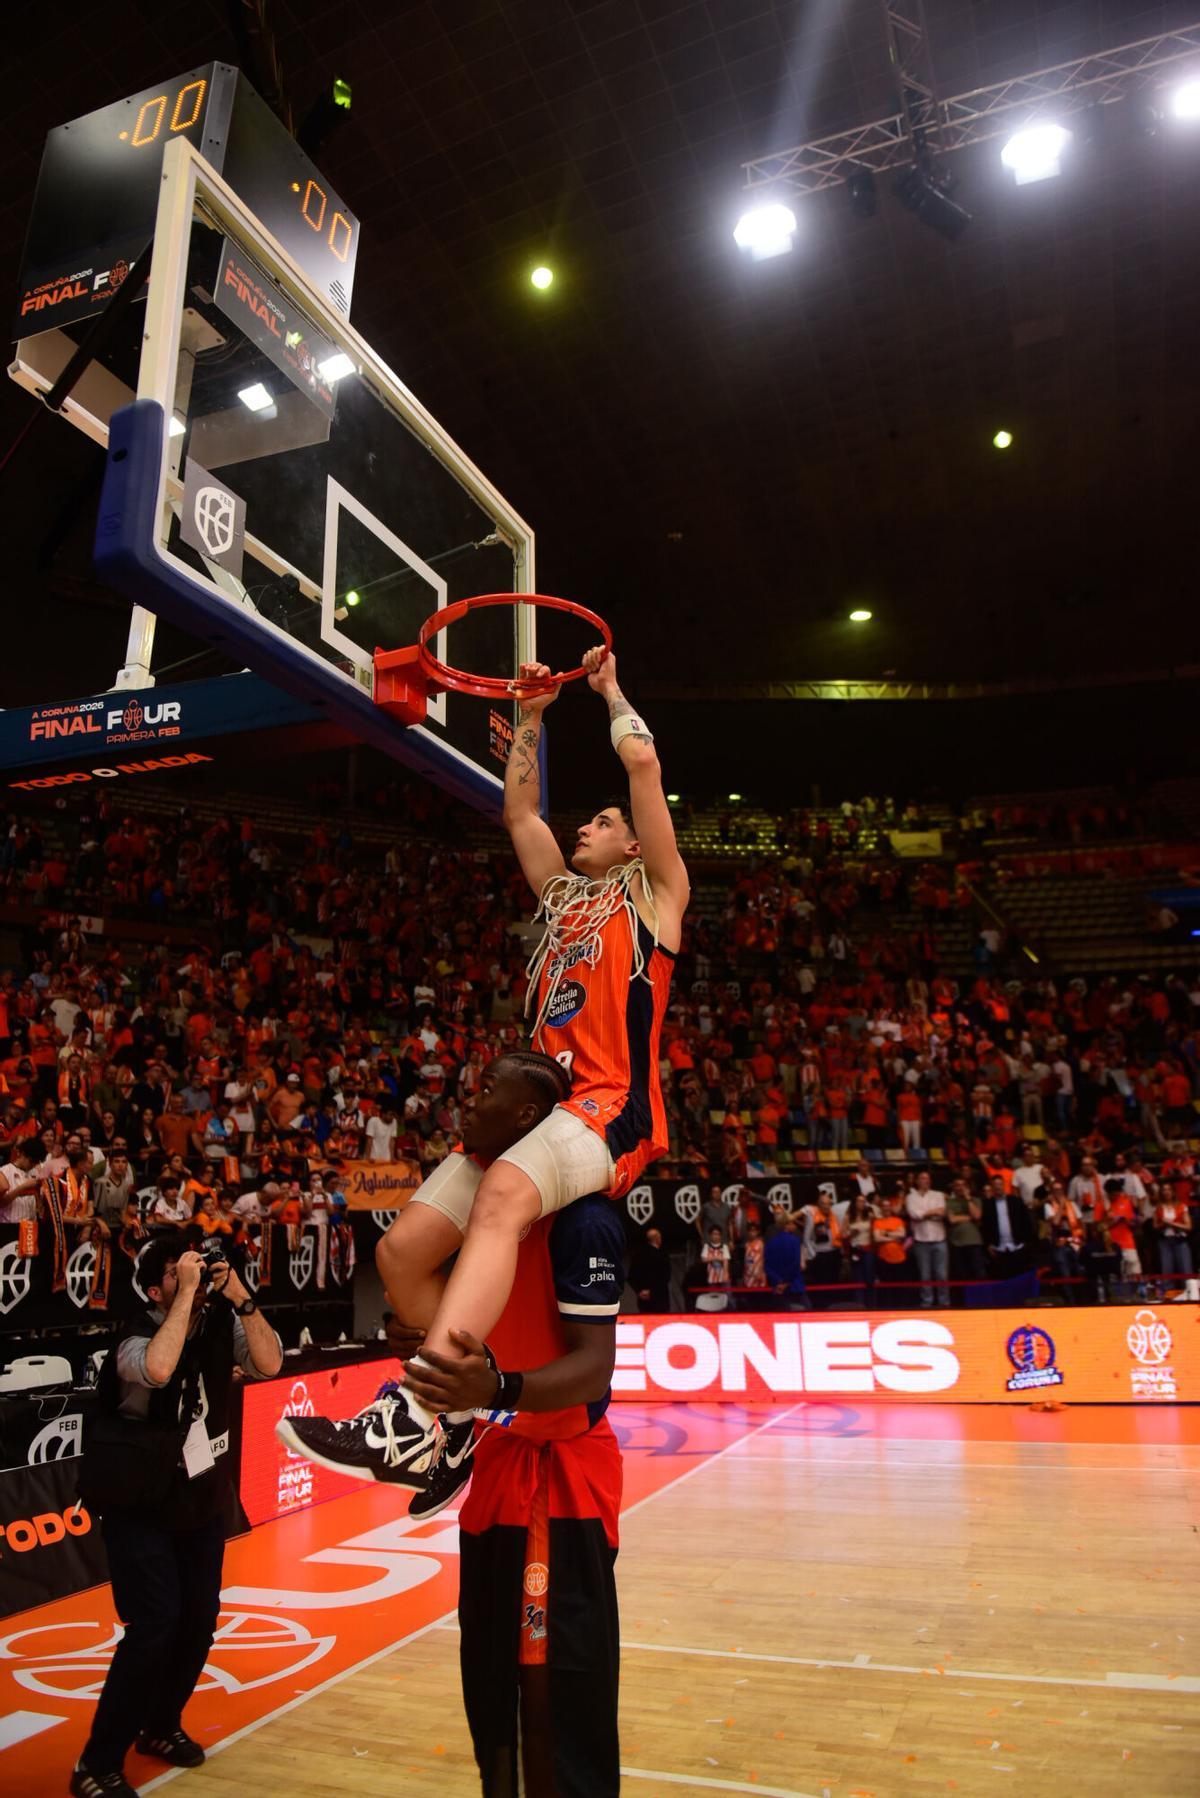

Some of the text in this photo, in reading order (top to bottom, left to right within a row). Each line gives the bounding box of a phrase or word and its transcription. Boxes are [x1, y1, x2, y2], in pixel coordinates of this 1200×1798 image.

[21, 281, 88, 316] FINAL
[224, 266, 281, 338] FINAL
[31, 710, 39, 719] A
[30, 714, 102, 741] FINAL
[106, 726, 181, 744] PRIMERA FEB
[489, 714, 514, 743] FINA
[8, 752, 215, 791] TODO O NADA
[552, 988, 578, 1005] strella
[1130, 1370, 1176, 1383] FINAL
[59, 1420, 78, 1432] FEB
[278, 1467, 314, 1489] FINAL
[0, 1505, 92, 1553] ODO
